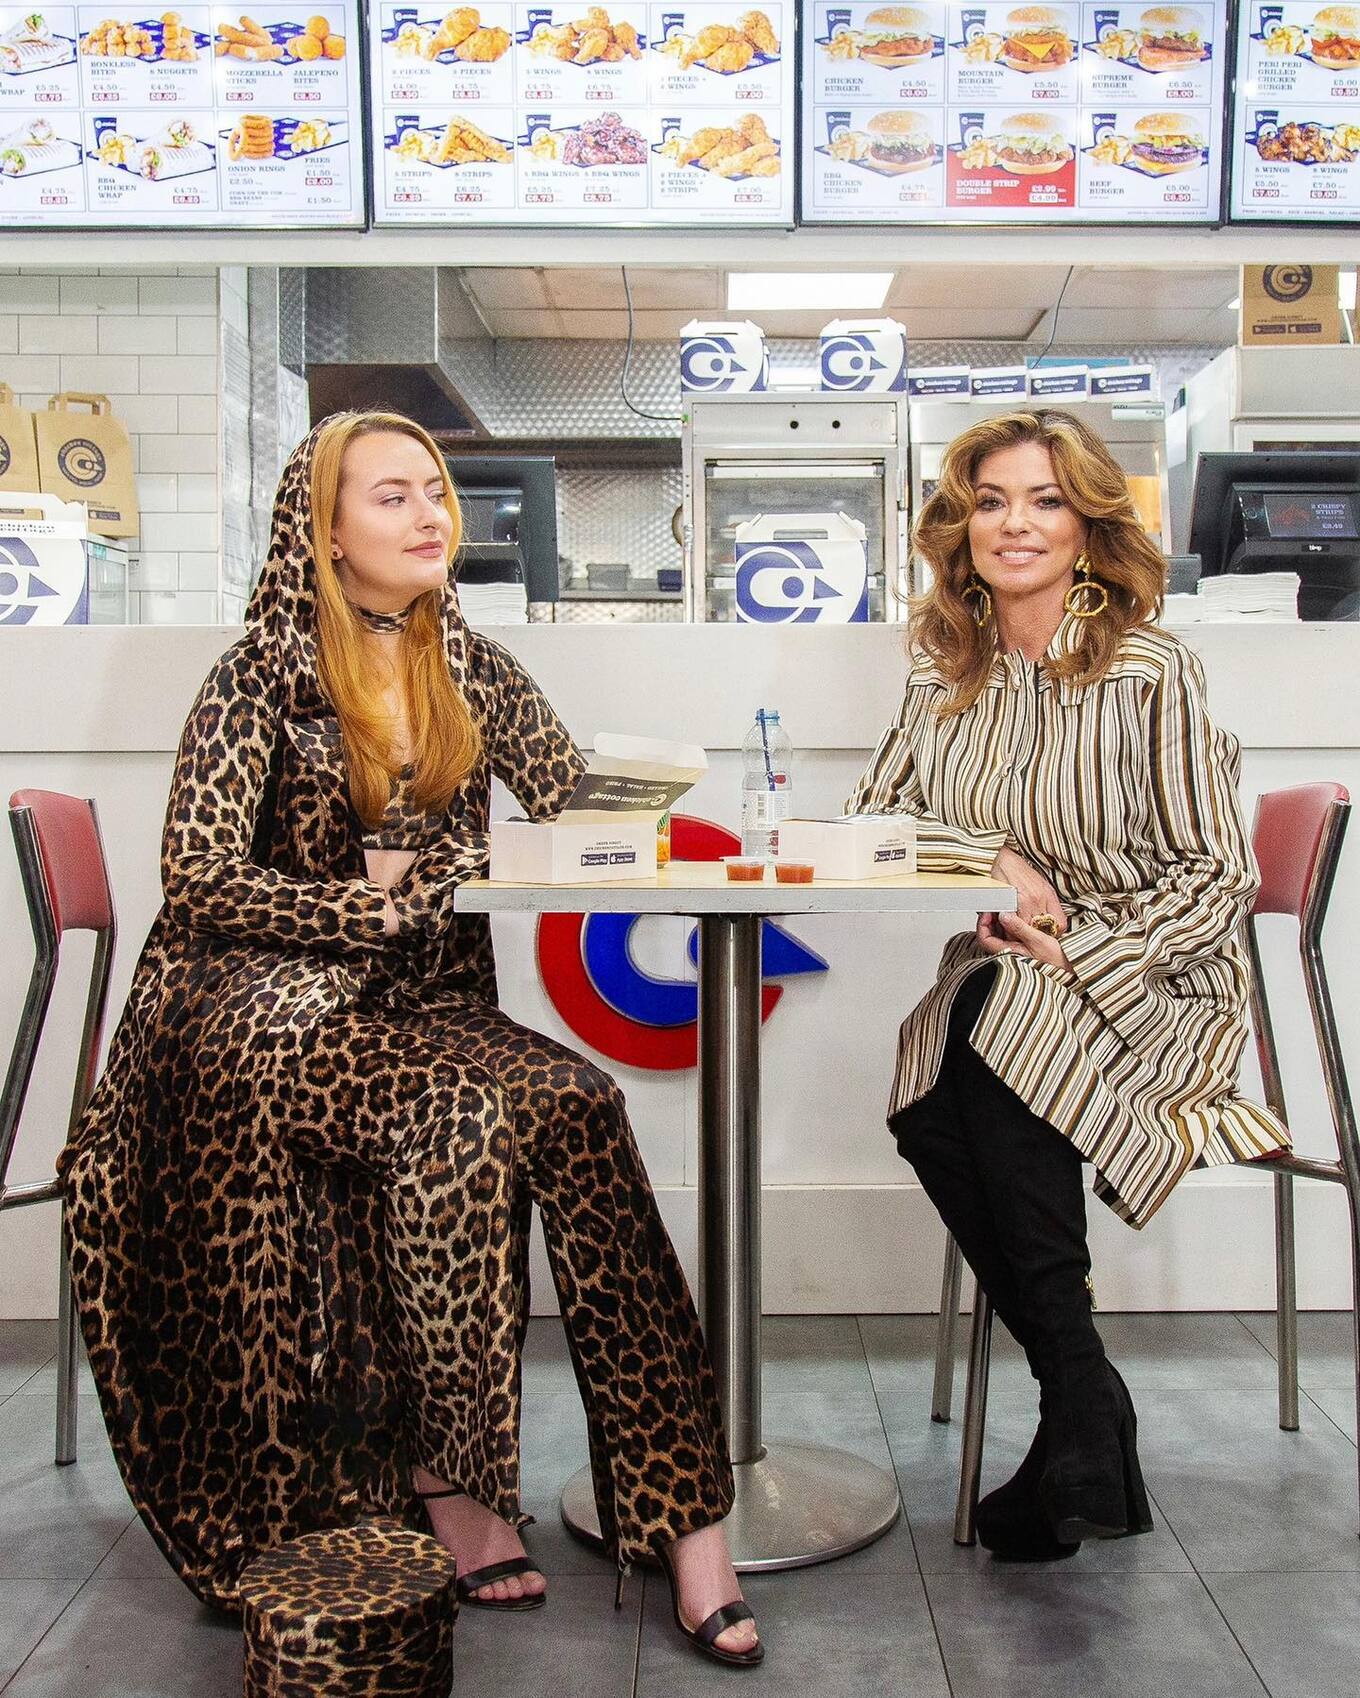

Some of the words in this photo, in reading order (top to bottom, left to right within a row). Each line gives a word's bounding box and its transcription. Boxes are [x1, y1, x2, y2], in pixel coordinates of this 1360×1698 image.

[956, 179, 992, 187] DOUBLE
[993, 179, 1021, 187] STRIP
[588, 792, 621, 801] cottage
